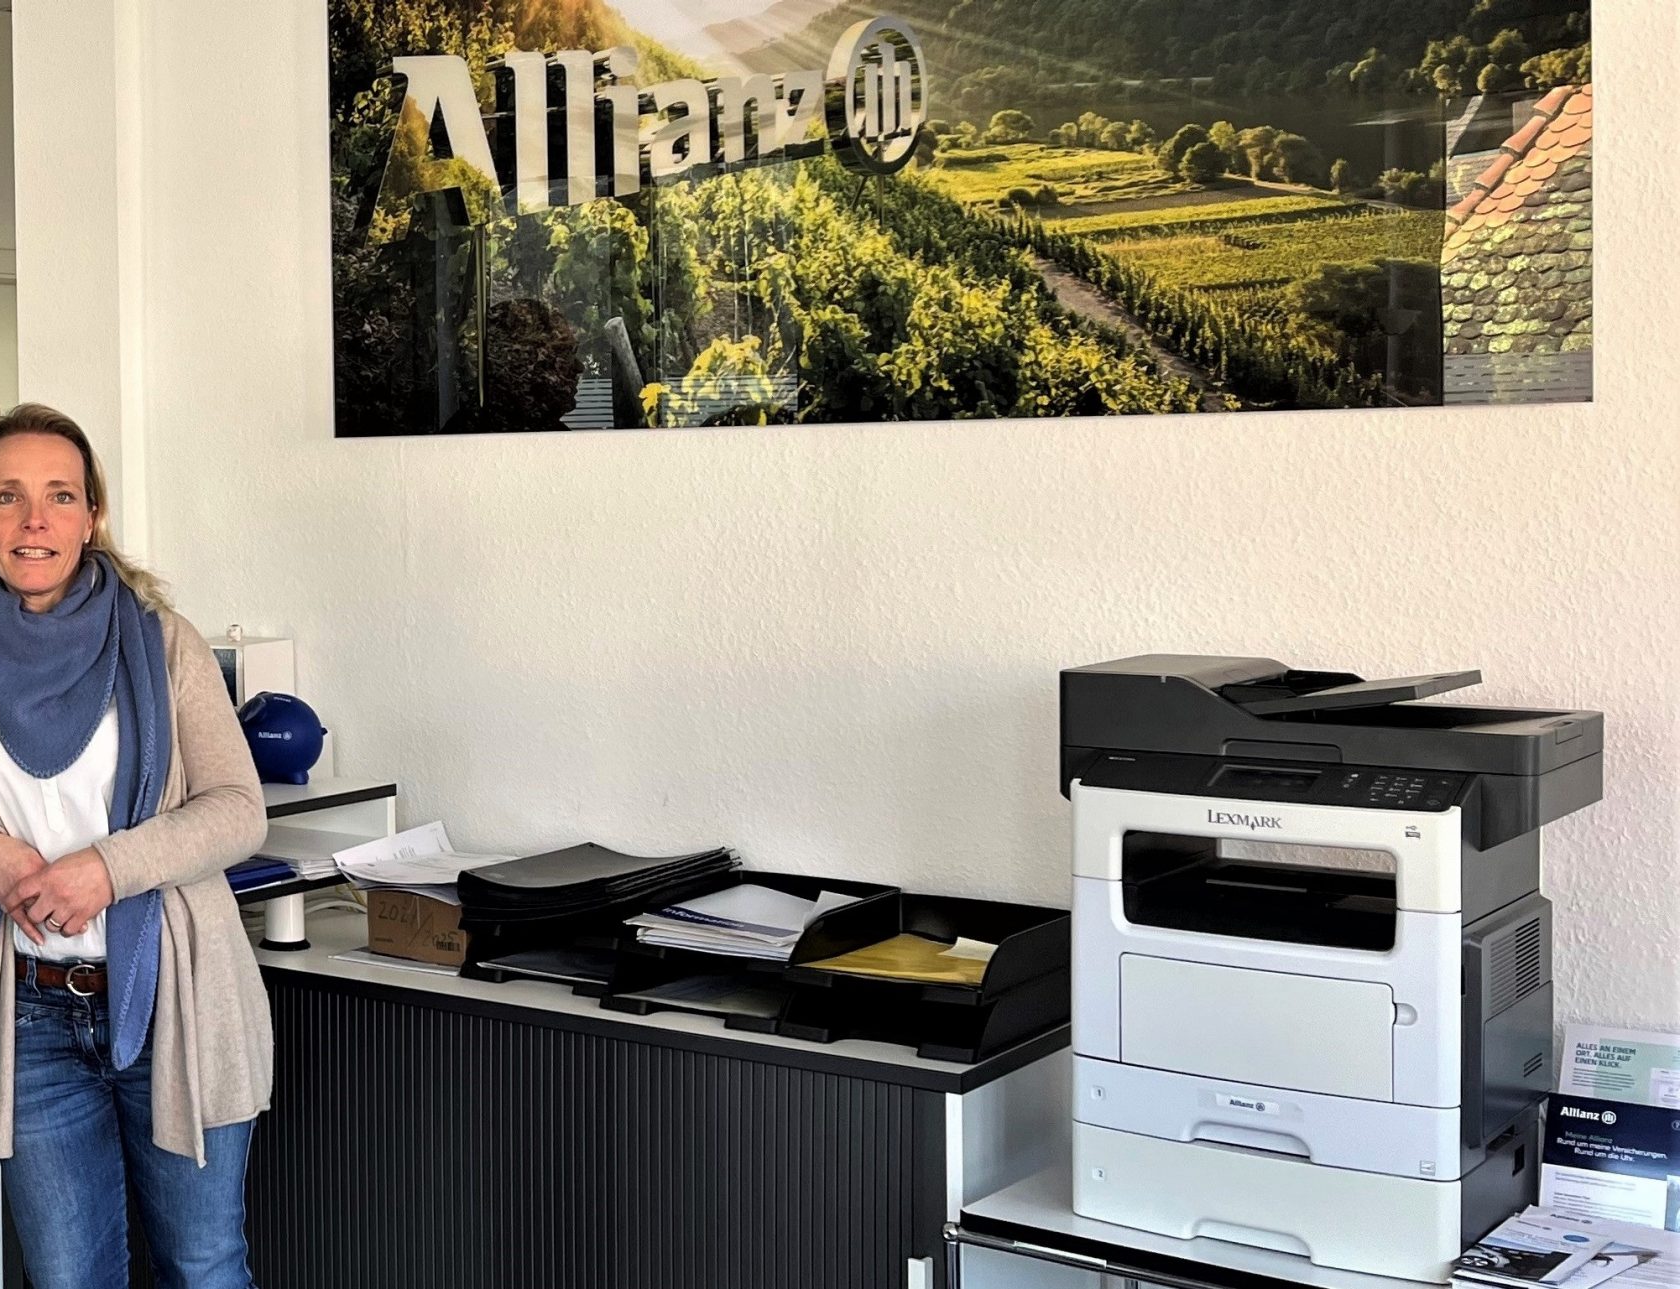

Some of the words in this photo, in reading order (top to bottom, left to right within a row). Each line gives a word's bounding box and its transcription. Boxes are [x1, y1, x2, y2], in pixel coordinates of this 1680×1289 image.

[363, 46, 827, 247] Allianz
[258, 731, 282, 739] Allianz
[1576, 1042, 1598, 1051] ALLES
[1612, 1046, 1637, 1055] EINEM
[1575, 1056, 1597, 1065] EINEN
[1594, 1052, 1616, 1060] ALLES
[1229, 1099, 1255, 1109] Allianz
[1560, 1106, 1600, 1121] Allianz
[1565, 1130, 1588, 1140] Meine
[1556, 1137, 1576, 1146] Rund
[1589, 1142, 1611, 1151] meine
[1574, 1147, 1594, 1156] Rund
[1607, 1151, 1620, 1160] die
[1098, 1170, 1103, 1178] 2
